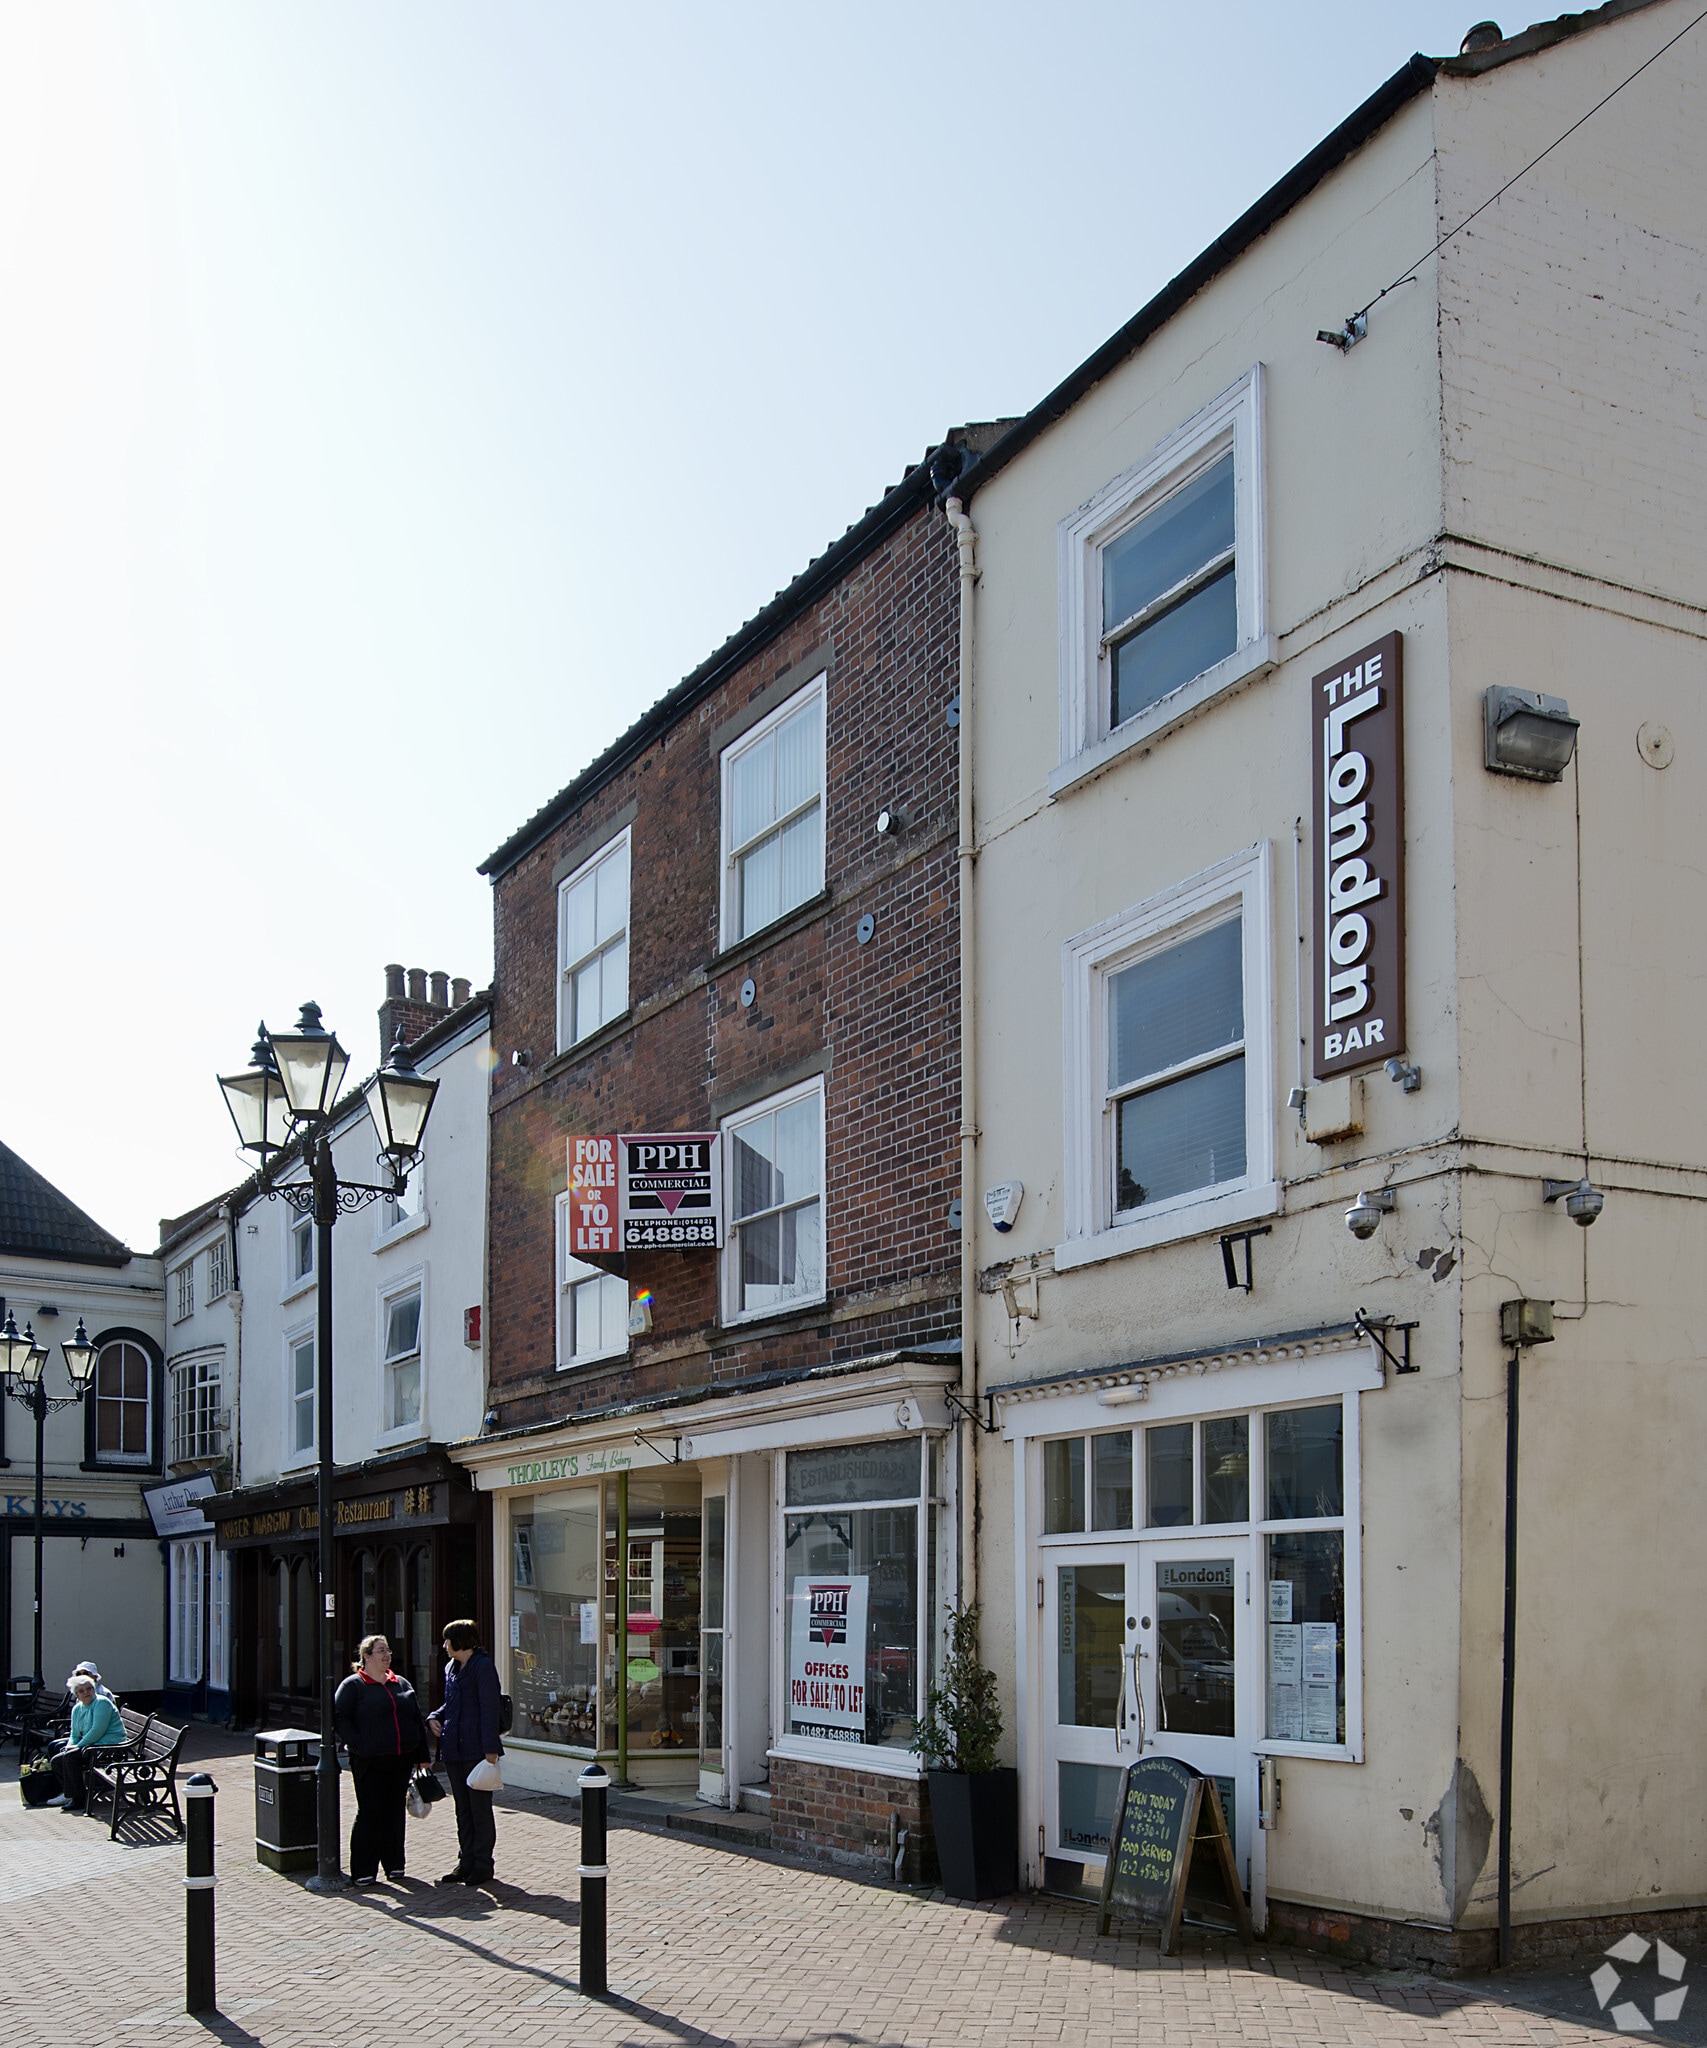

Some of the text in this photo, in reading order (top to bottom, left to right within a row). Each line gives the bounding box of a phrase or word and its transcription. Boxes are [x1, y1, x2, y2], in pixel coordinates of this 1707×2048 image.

[1323, 653, 1383, 706] THE
[1328, 685, 1384, 1024] London
[1323, 1018, 1385, 1061] BAR
[575, 1139, 612, 1163] FOR
[636, 1144, 702, 1170] PPH
[572, 1163, 616, 1188] SALE
[631, 1178, 708, 1190] COMMERCIAL
[587, 1189, 602, 1201] OR
[579, 1203, 609, 1227] TO
[577, 1226, 613, 1250] LET
[625, 1225, 716, 1243] 648888
[625, 1240, 716, 1250] www.pph-commercial.co.uk
[507, 1455, 580, 1485] THORLEY'S
[800, 1460, 878, 1490] ESTABLISHED
[4, 1494, 87, 1517] KEYS
[161, 1490, 186, 1512] Arthur
[253, 1511, 291, 1536] MARGIN
[298, 1506, 319, 1530] Chin
[337, 1496, 391, 1525] Restaurant
[1170, 1567, 1225, 1584] London
[813, 1591, 844, 1612] PPH
[811, 1618, 846, 1628] COMMERCIAL
[1064, 1581, 1073, 1647] London
[804, 1661, 849, 1680] OFFICES
[792, 1679, 808, 1707] FOR
[848, 1685, 864, 1714] LET
[800, 1724, 861, 1744] 01482 648888
[1127, 1789, 1178, 1811] OPEN TODAY
[1120, 1837, 1173, 1863] FOOD SERVED
